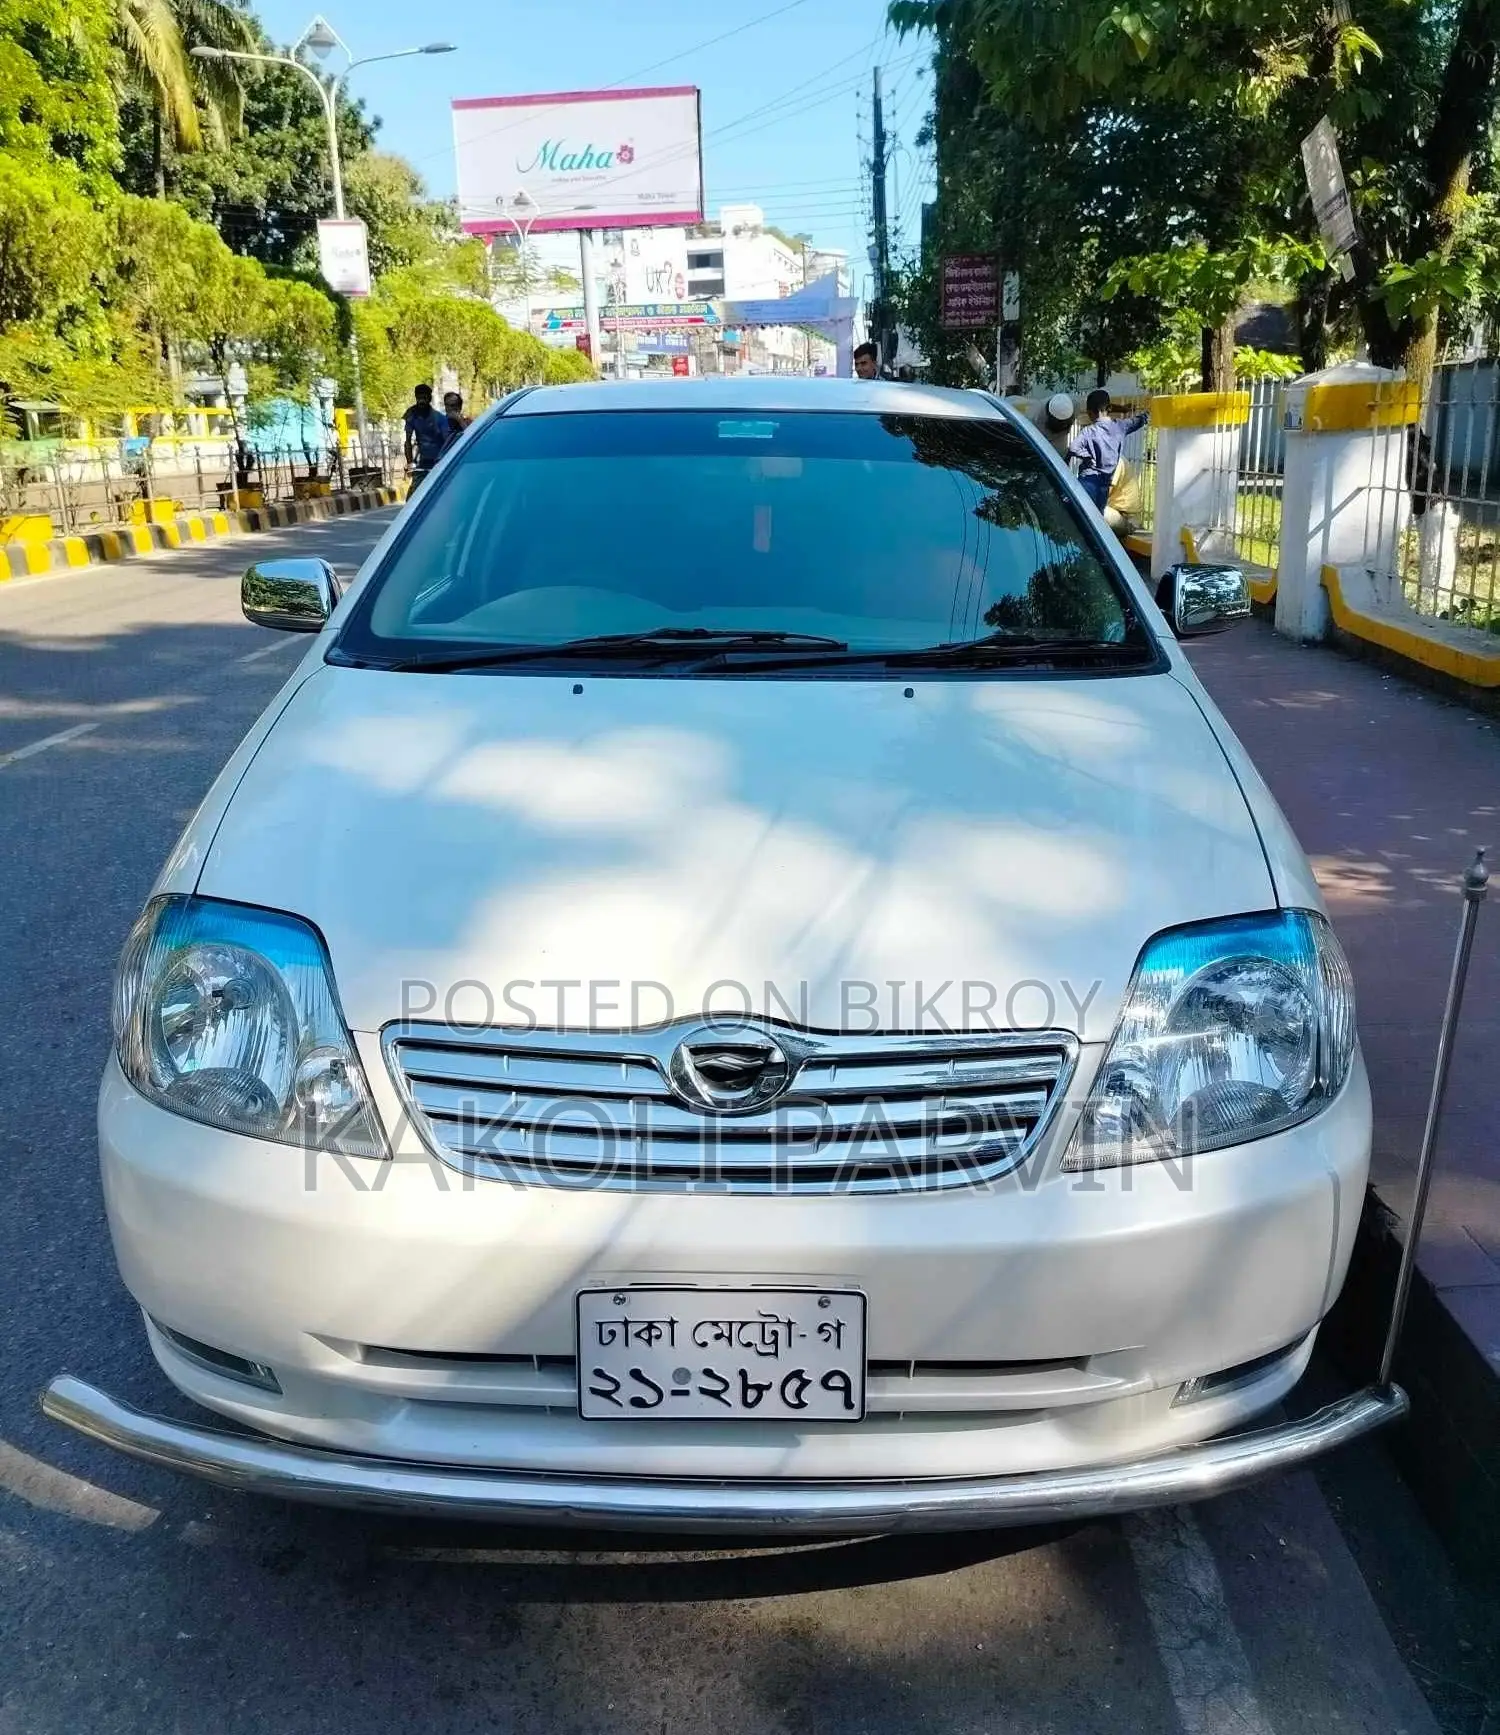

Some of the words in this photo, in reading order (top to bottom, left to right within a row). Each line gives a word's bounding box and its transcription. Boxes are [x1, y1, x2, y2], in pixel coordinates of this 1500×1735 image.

[516, 138, 614, 173] Maha
[595, 1316, 678, 1347] ঢাকা
[589, 1368, 855, 1409] ২১-২৮৫৭
